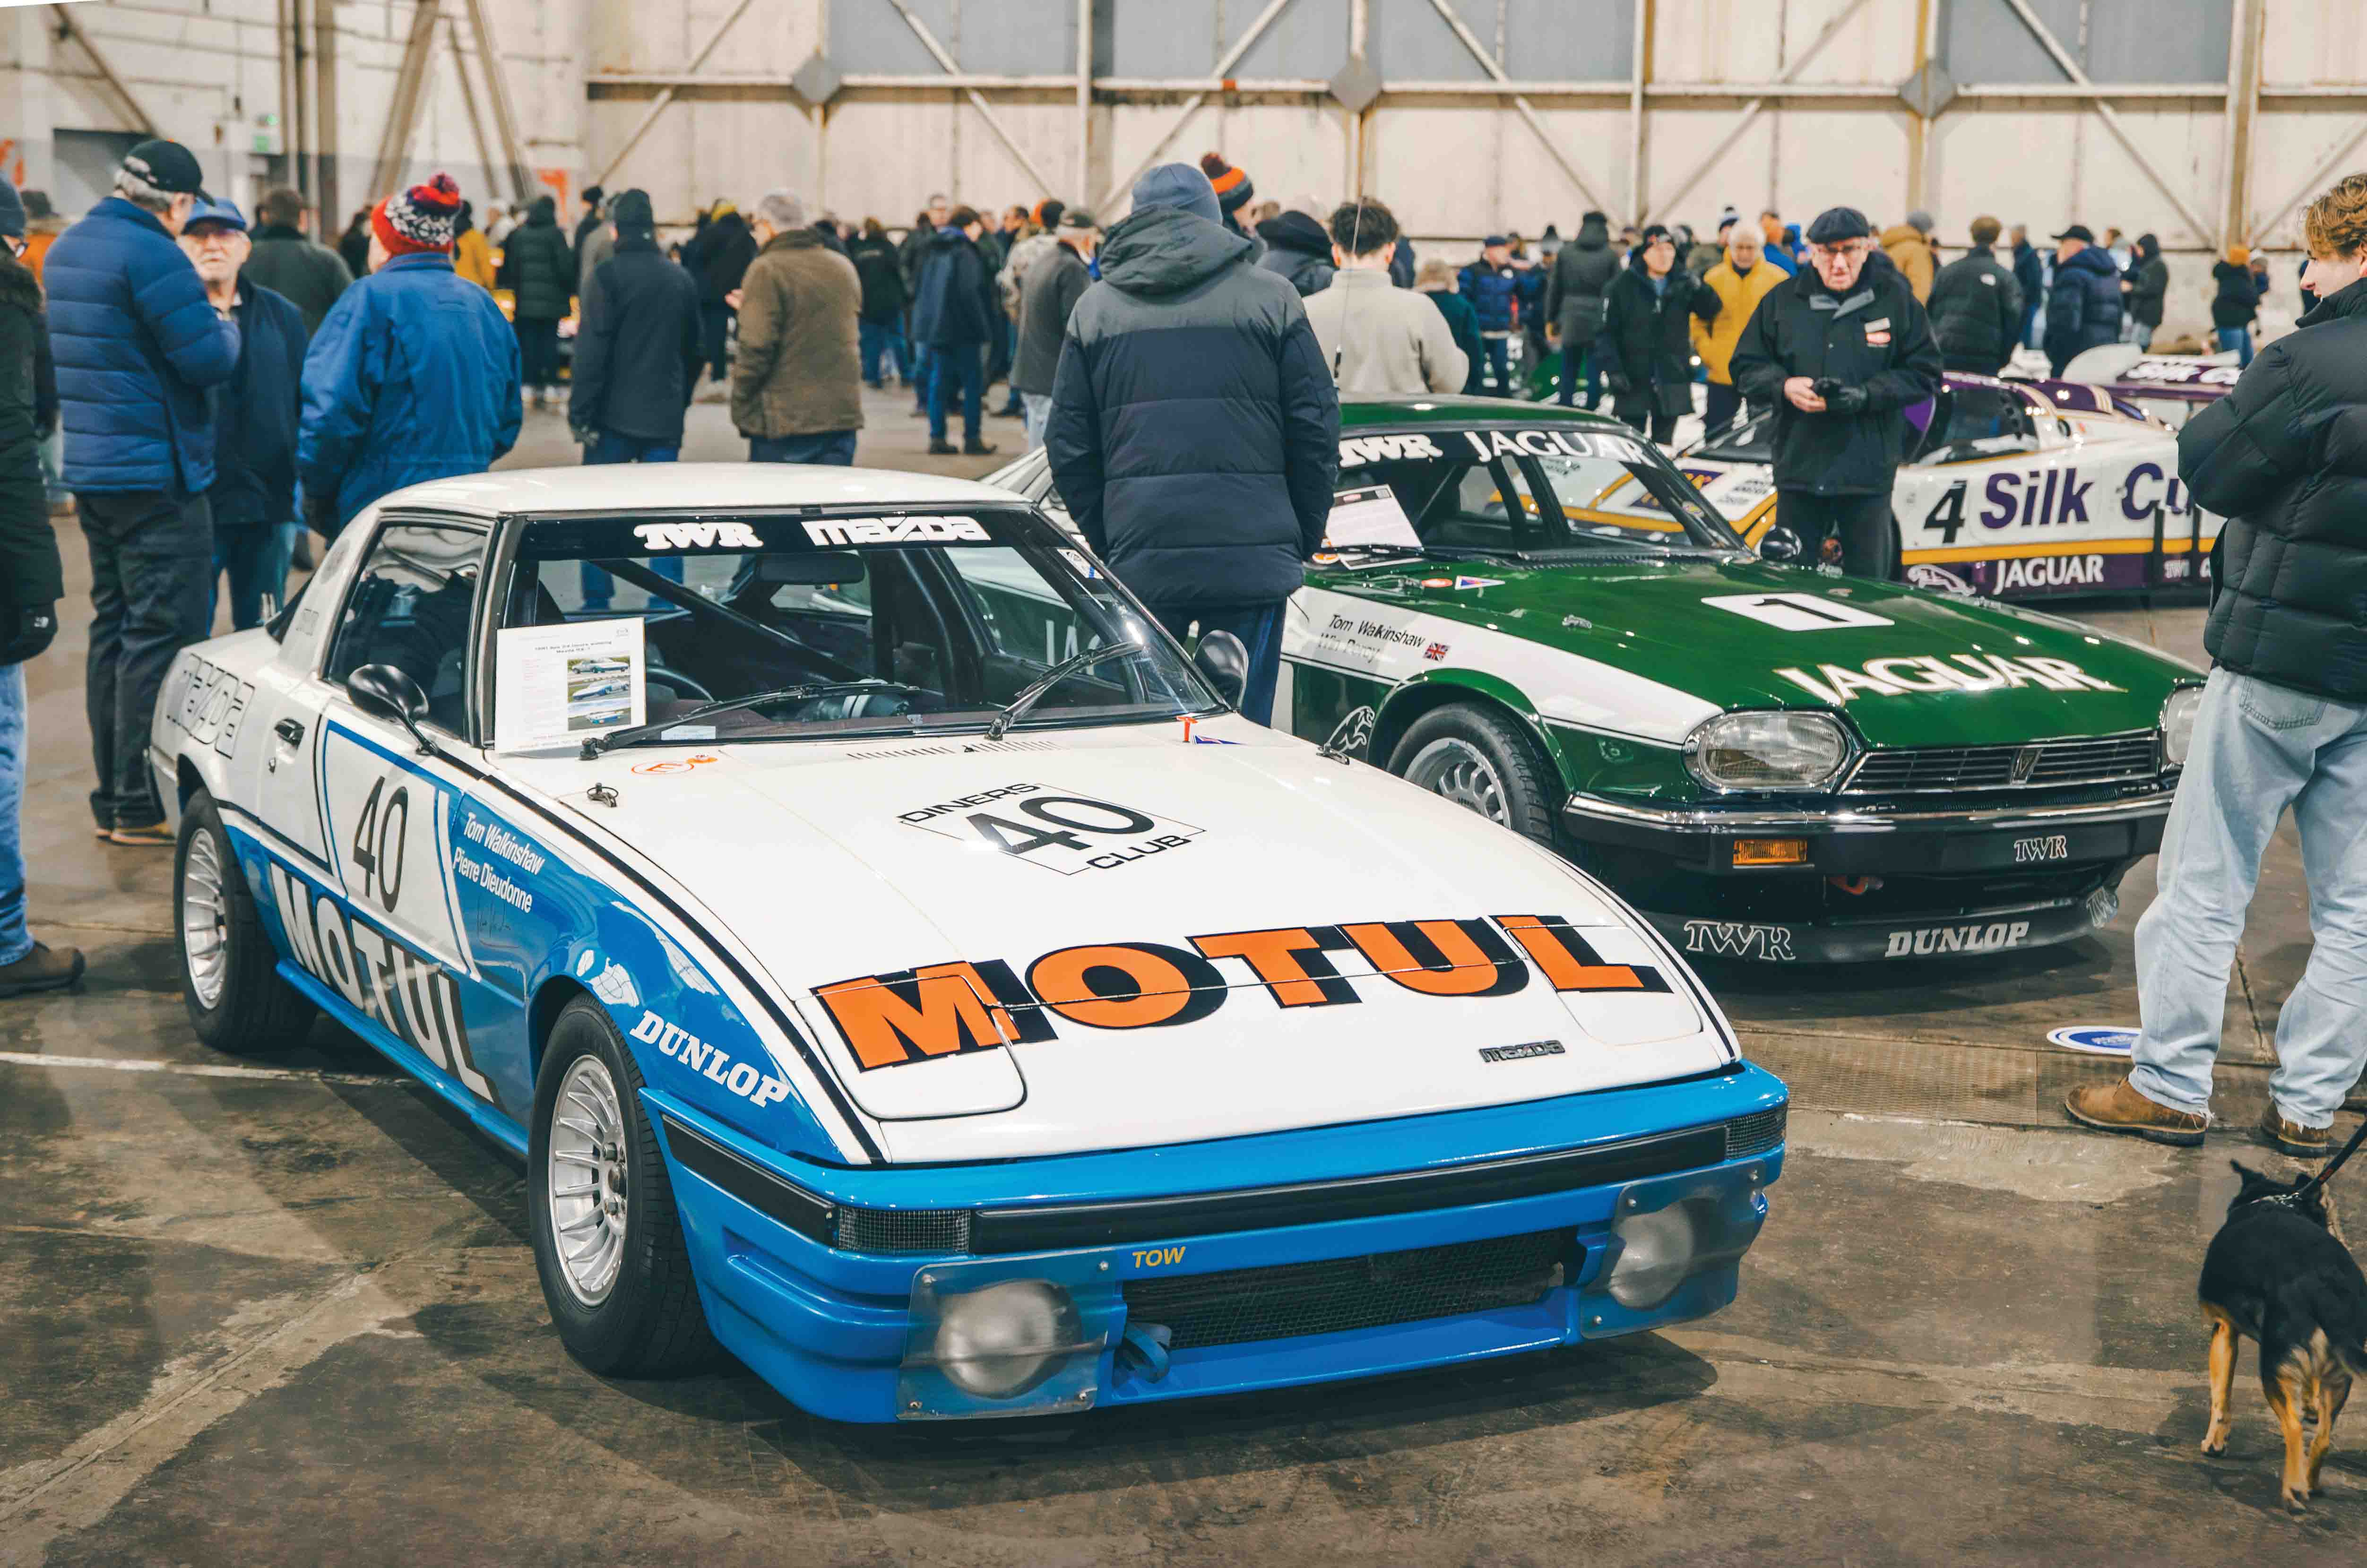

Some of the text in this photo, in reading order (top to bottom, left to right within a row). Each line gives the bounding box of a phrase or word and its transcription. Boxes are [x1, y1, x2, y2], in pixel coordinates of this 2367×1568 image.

[1464, 431, 1657, 468] JAGUAR
[1924, 480, 1967, 543] 4
[1980, 463, 2193, 529] Silk Cu
[633, 521, 764, 550] TWR
[1994, 554, 2104, 595] JAGUAR
[1329, 614, 1425, 648] Tom Walkinshaw
[1753, 597, 1853, 624] 1
[1773, 653, 2128, 707] JAGUAR
[897, 783, 1040, 823] DINERS
[353, 776, 408, 913] 40
[464, 812, 545, 875] Tom Walkinshaw
[966, 796, 1154, 854] 40
[1086, 834, 1192, 870] CLUB
[2013, 835, 2068, 862] TWR
[452, 846, 533, 913] Pierre Dieudonne
[1683, 920, 1796, 961] TWR
[1885, 921, 2030, 958] DUNLOP
[270, 861, 507, 1113] MOTUL
[809, 914, 1673, 1073] MOTUL
[630, 1009, 790, 1108] DUNLOP
[1132, 1246, 1186, 1269] TOW
